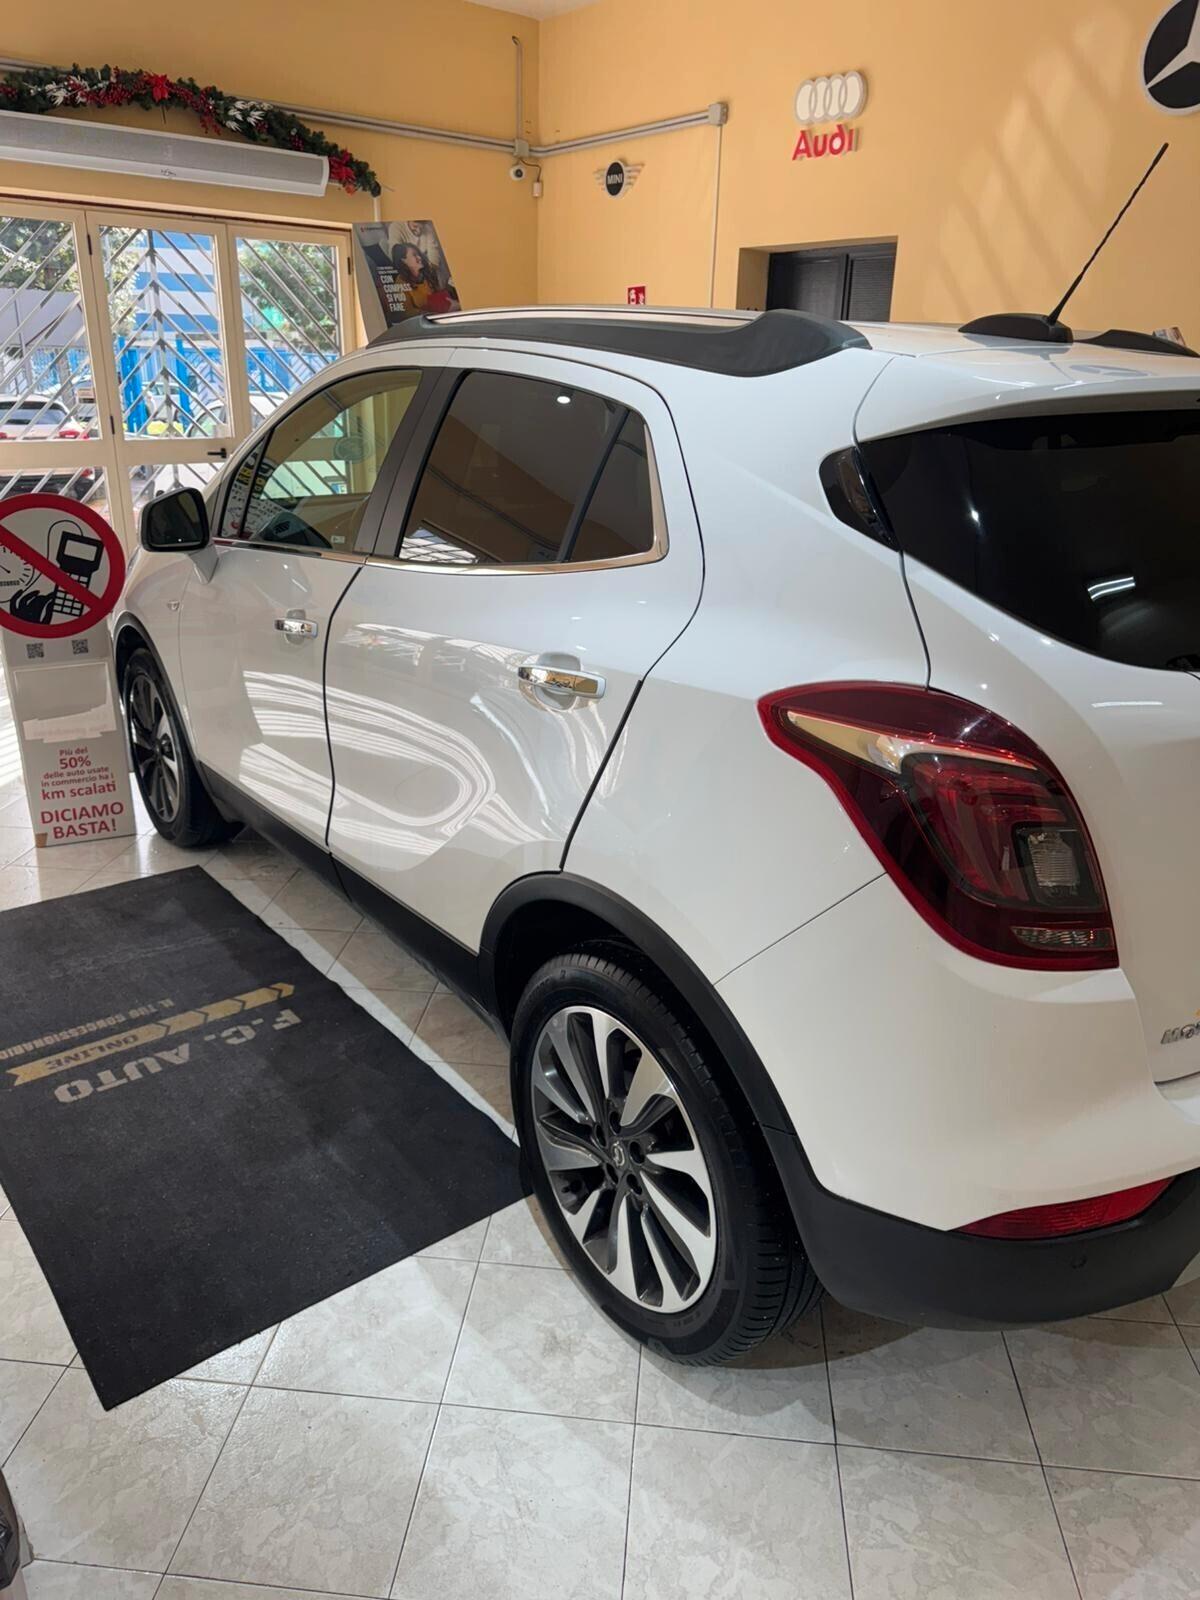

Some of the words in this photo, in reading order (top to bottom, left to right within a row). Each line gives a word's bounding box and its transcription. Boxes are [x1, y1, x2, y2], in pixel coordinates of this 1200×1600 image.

[791, 123, 856, 162] Audi
[606, 173, 623, 185] MINI
[384, 283, 412, 293] COMPASS
[389, 303, 405, 312] FARE
[75, 745, 88, 754] del
[59, 755, 91, 770] 50%
[41, 780, 50, 788] in
[51, 775, 97, 787] commercio
[98, 773, 109, 781] ha
[43, 770, 64, 780] delle
[66, 769, 85, 777] auto
[87, 766, 109, 774] usate
[41, 788, 65, 801] km
[70, 780, 117, 798] scalati
[40, 801, 124, 824] DICIAMO
[53, 818, 117, 839] BASTA!
[128, 1005, 158, 1019] TUO
[204, 1008, 303, 1046] F.C.
[45, 1033, 139, 1072] ONLINE
[54, 1042, 191, 1104] AUTO
